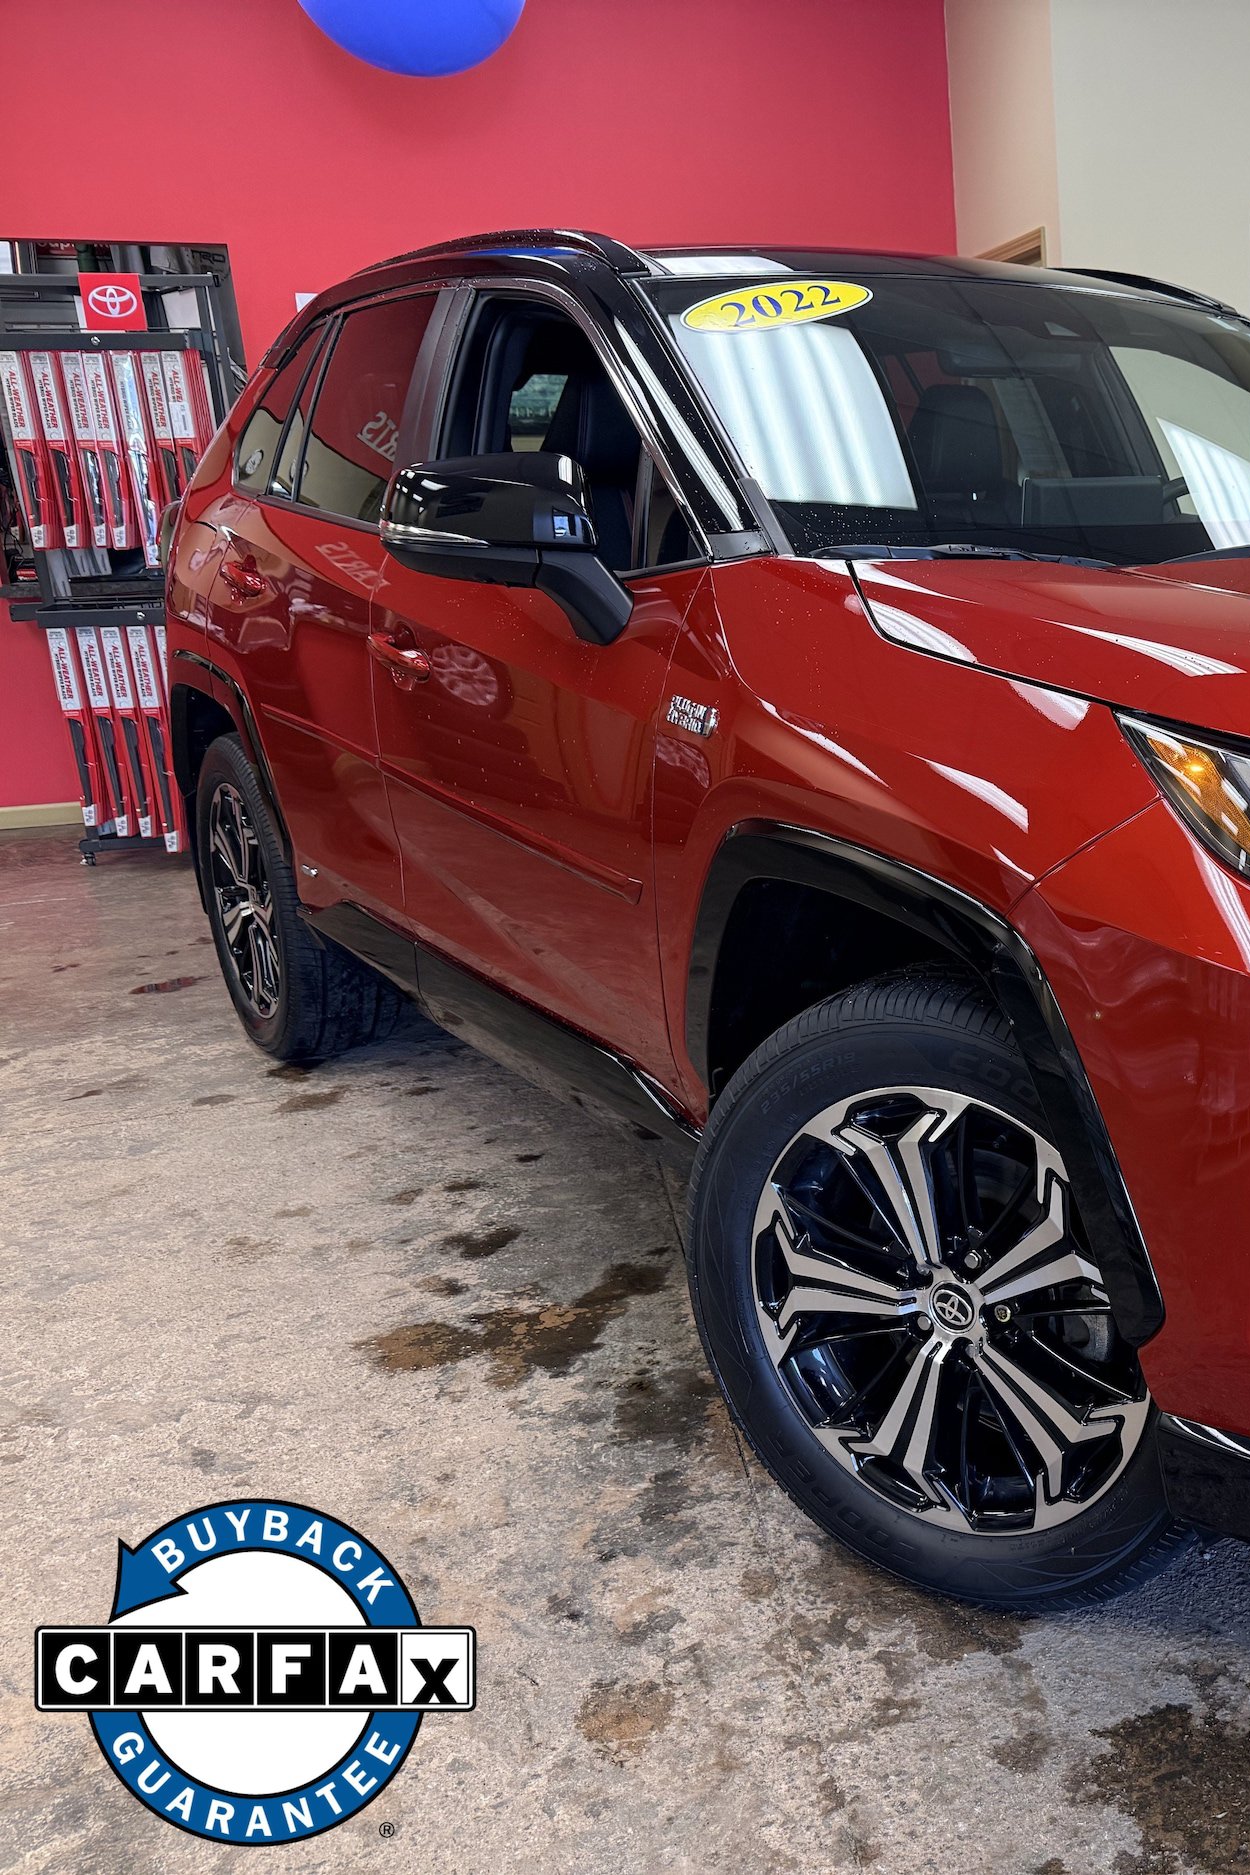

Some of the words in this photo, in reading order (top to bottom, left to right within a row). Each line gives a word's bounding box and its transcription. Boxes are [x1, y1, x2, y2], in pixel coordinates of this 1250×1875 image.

[720, 285, 841, 327] 2022
[9, 370, 26, 428] ALL-WEATHER
[41, 371, 58, 429] ALL-WEATHER
[72, 372, 89, 429] ALL-WEATHER
[94, 372, 109, 429] ALL-WEATHER
[151, 371, 166, 428] ALL-WEATHER
[172, 369, 183, 402] ALL-WE
[58, 646, 74, 699] ALL-WEATHER
[87, 643, 103, 696] ALL-WEATHER
[112, 644, 127, 698] ALL-WEATHER
[138, 644, 152, 696] ALL-WEATHER
[759, 1052, 857, 1115] 235/55R19
